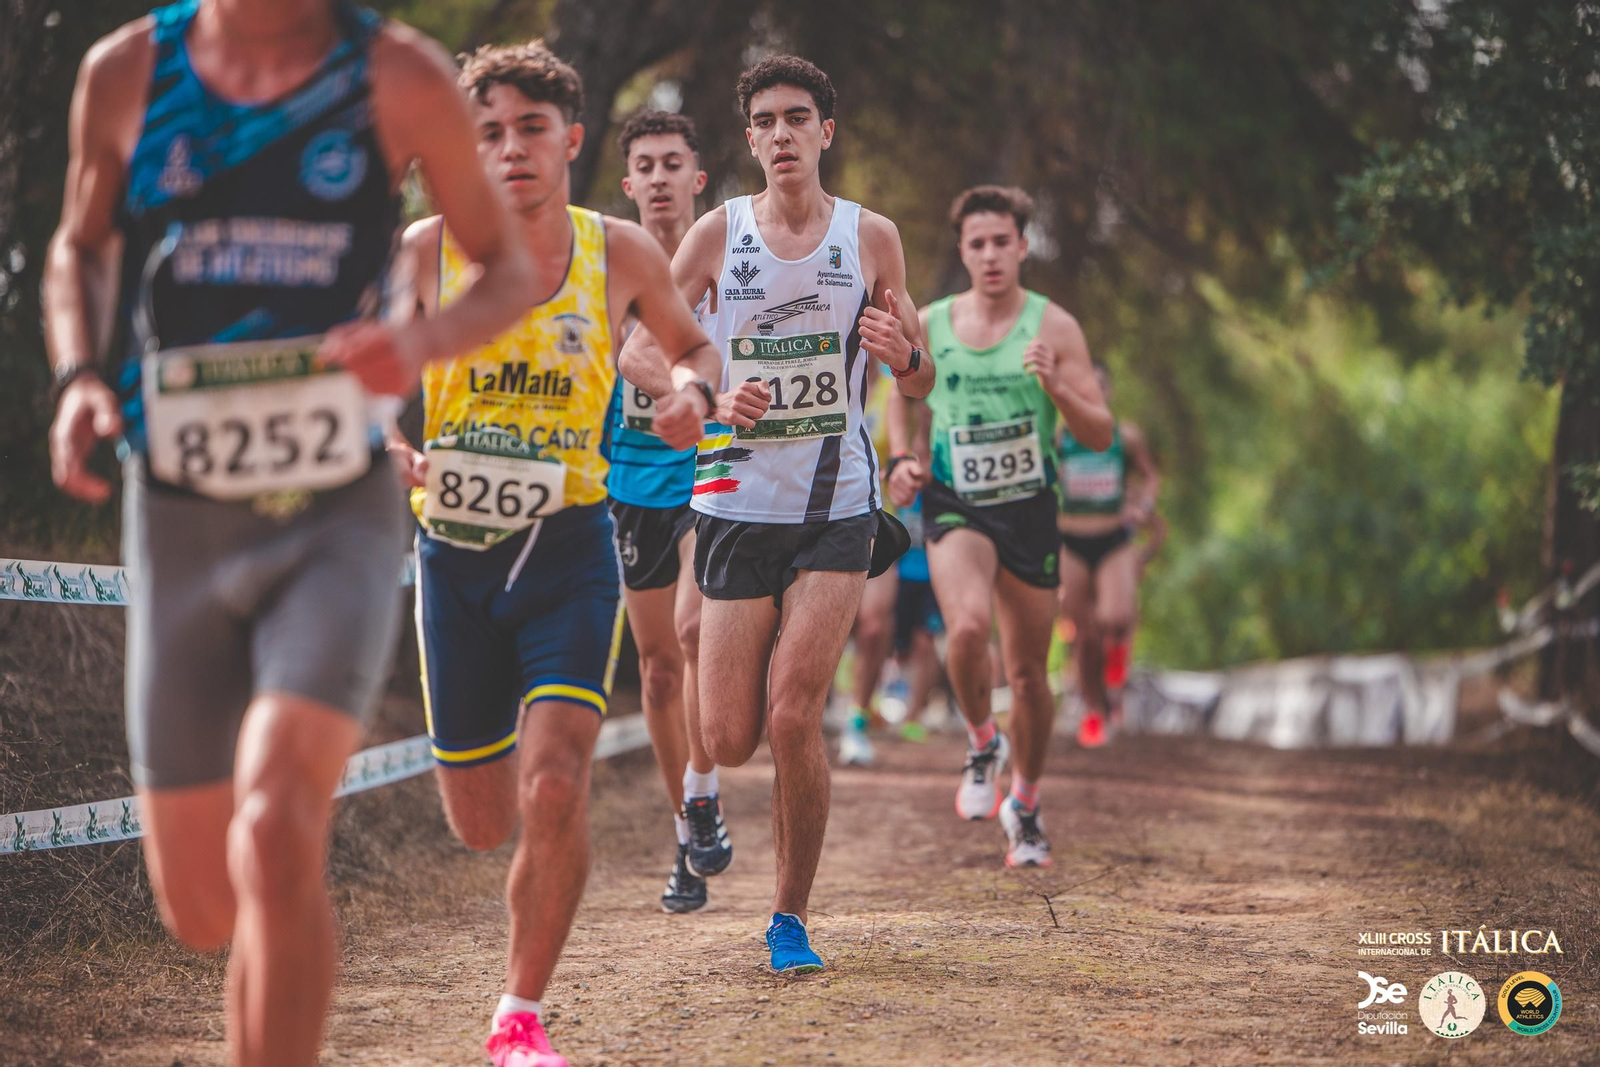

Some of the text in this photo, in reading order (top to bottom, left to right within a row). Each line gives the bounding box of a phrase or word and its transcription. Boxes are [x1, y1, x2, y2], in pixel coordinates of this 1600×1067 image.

[817, 270, 853, 280] Ayuntamiento
[824, 279, 853, 288] Salamanca
[725, 288, 766, 296] CAJA RURAL
[760, 339, 813, 354] ITÁLICA
[745, 371, 839, 411] 128
[175, 407, 343, 476] 8252
[962, 448, 1035, 483] 8293
[439, 470, 552, 520] 8262
